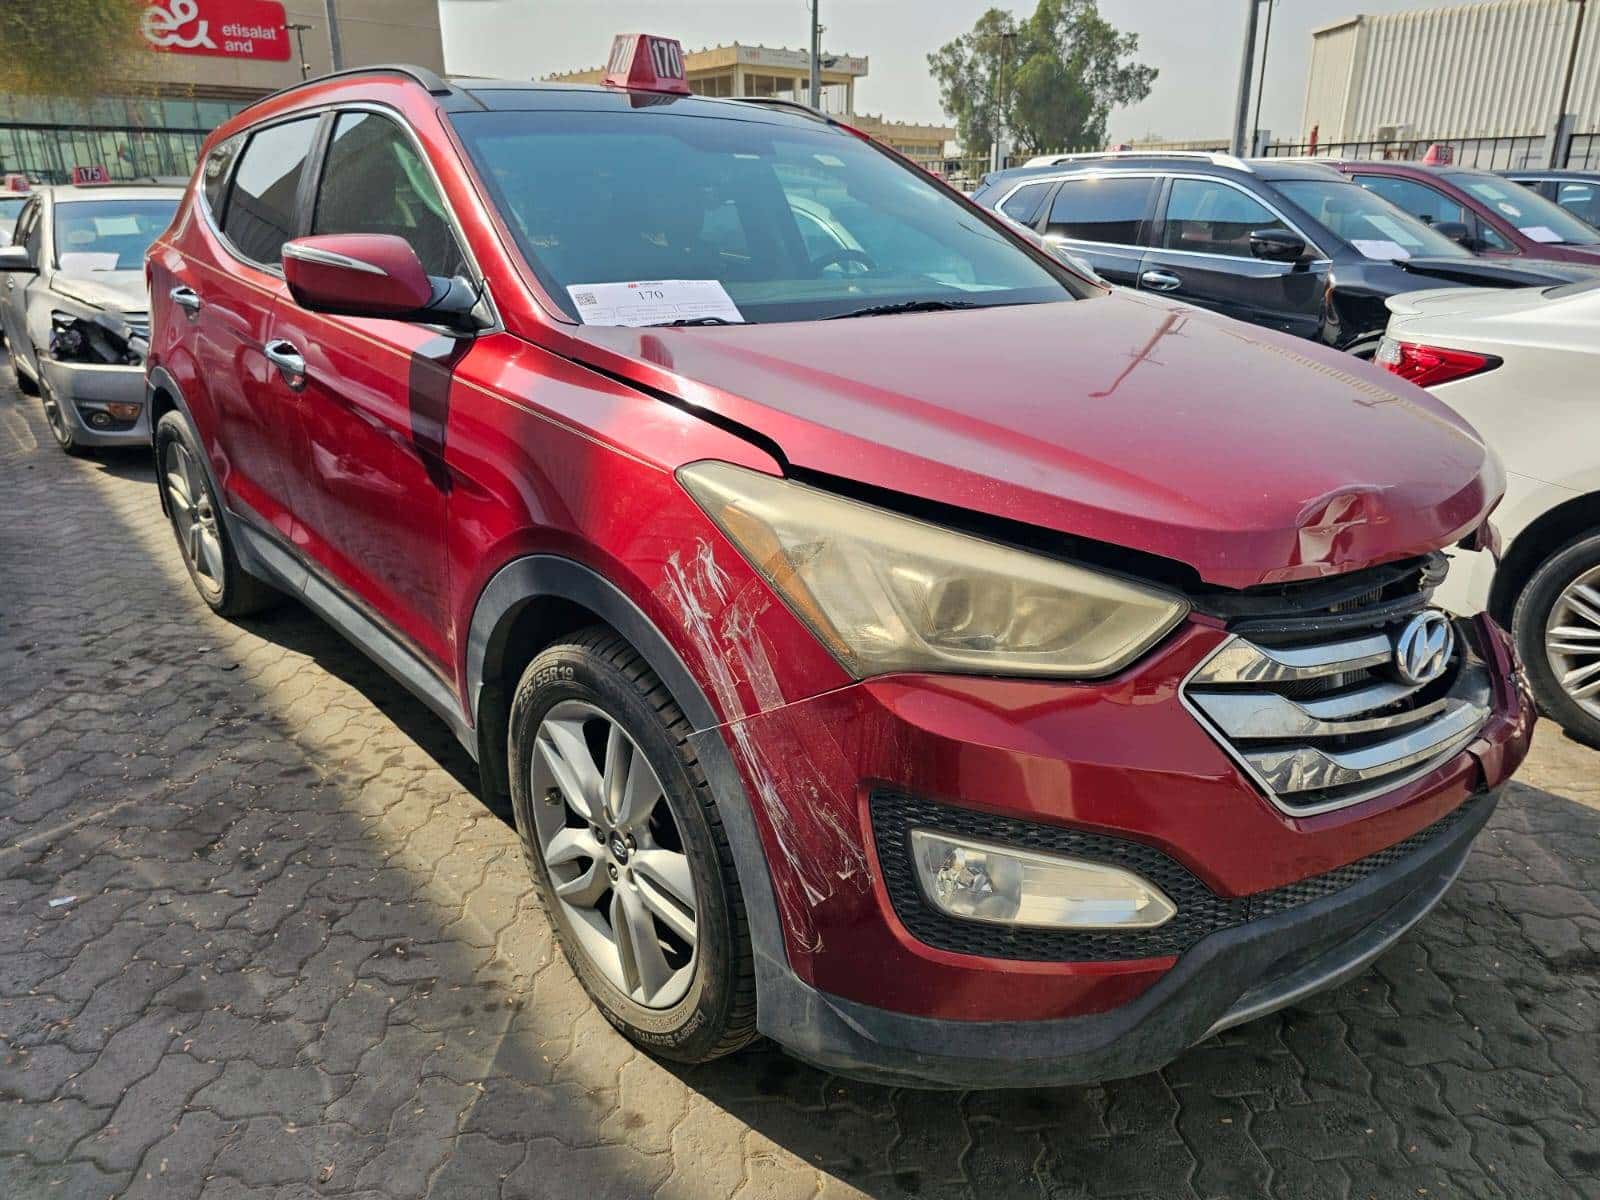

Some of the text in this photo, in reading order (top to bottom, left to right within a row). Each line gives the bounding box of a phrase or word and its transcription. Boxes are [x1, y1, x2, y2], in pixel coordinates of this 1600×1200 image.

[222, 23, 277, 40] etisalat
[224, 39, 253, 53] and
[652, 39, 682, 79] 170
[79, 167, 101, 180] 175
[637, 289, 664, 301] 170
